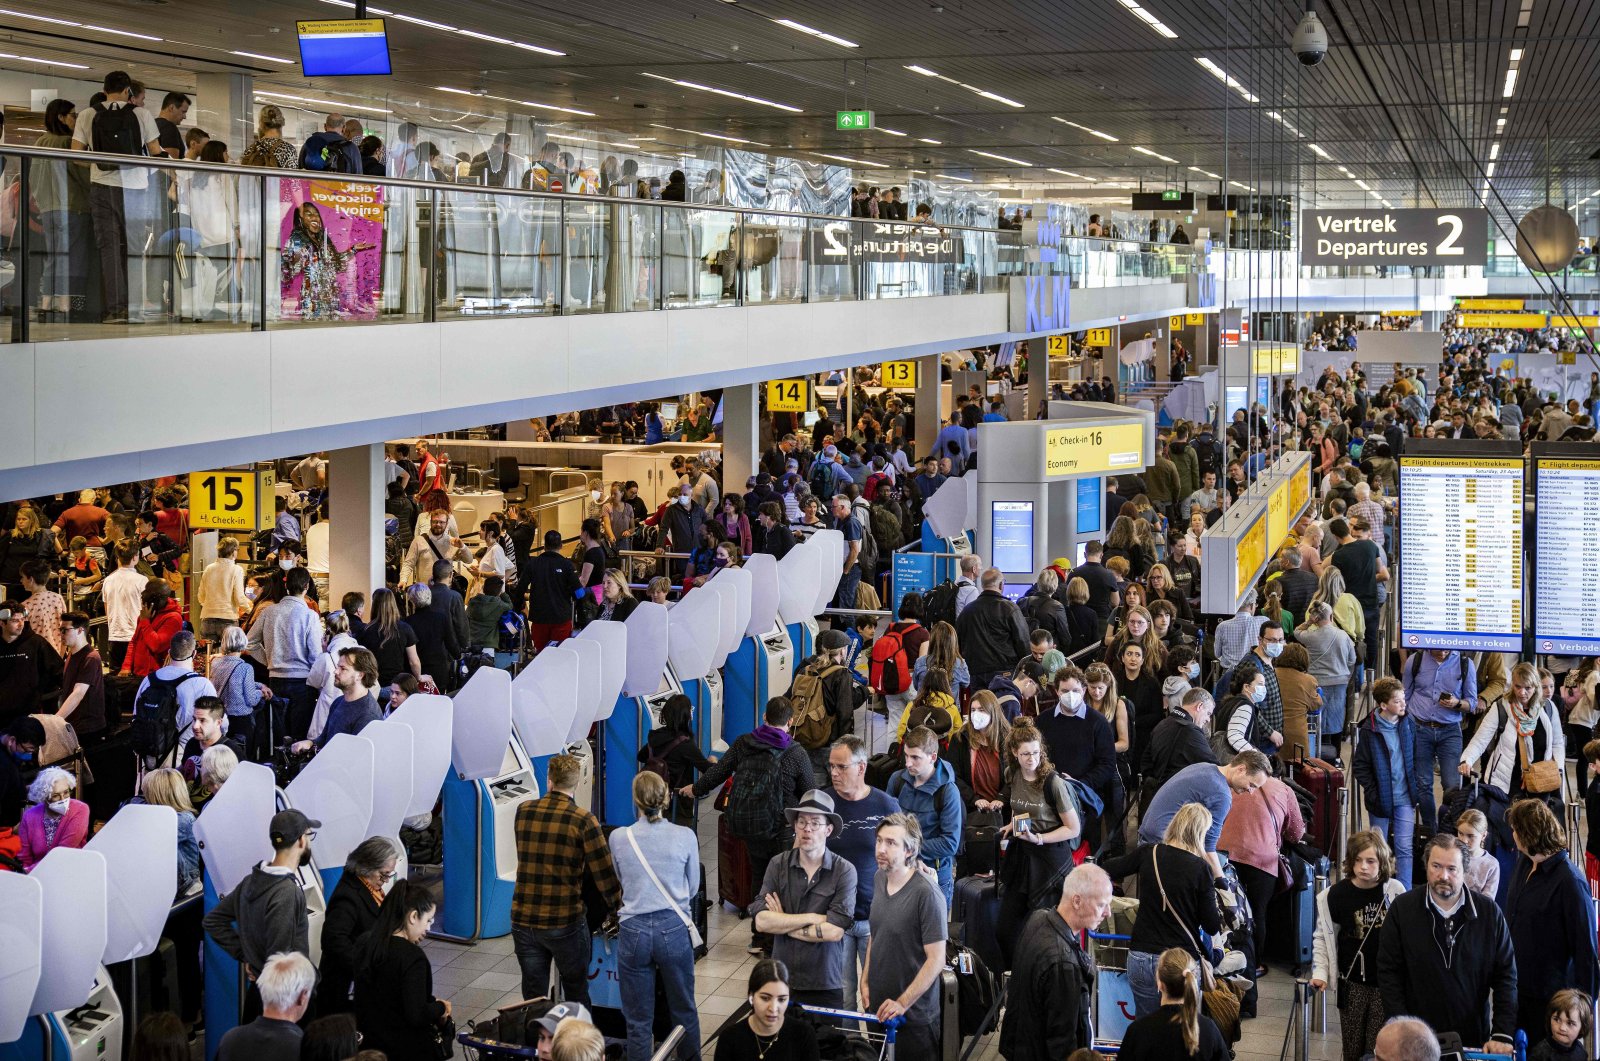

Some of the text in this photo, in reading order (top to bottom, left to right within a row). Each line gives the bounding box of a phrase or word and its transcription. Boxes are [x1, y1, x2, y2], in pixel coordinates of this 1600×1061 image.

[1316, 214, 1397, 233] Vertrek
[1317, 214, 1464, 260] Departures 2
[1025, 275, 1070, 332] KLM
[1092, 330, 1106, 342] 11
[1048, 338, 1062, 350] 12
[888, 364, 909, 380] 13
[775, 382, 800, 402] 14
[1060, 431, 1102, 446] Check-in 16
[1048, 460, 1078, 468] Economy
[264, 476, 272, 486] 15
[202, 476, 244, 511] 15
[212, 516, 246, 524] Check-in
[1424, 637, 1469, 646] Verboden
[1484, 639, 1510, 648] roken
[1560, 643, 1599, 652] Verbode
